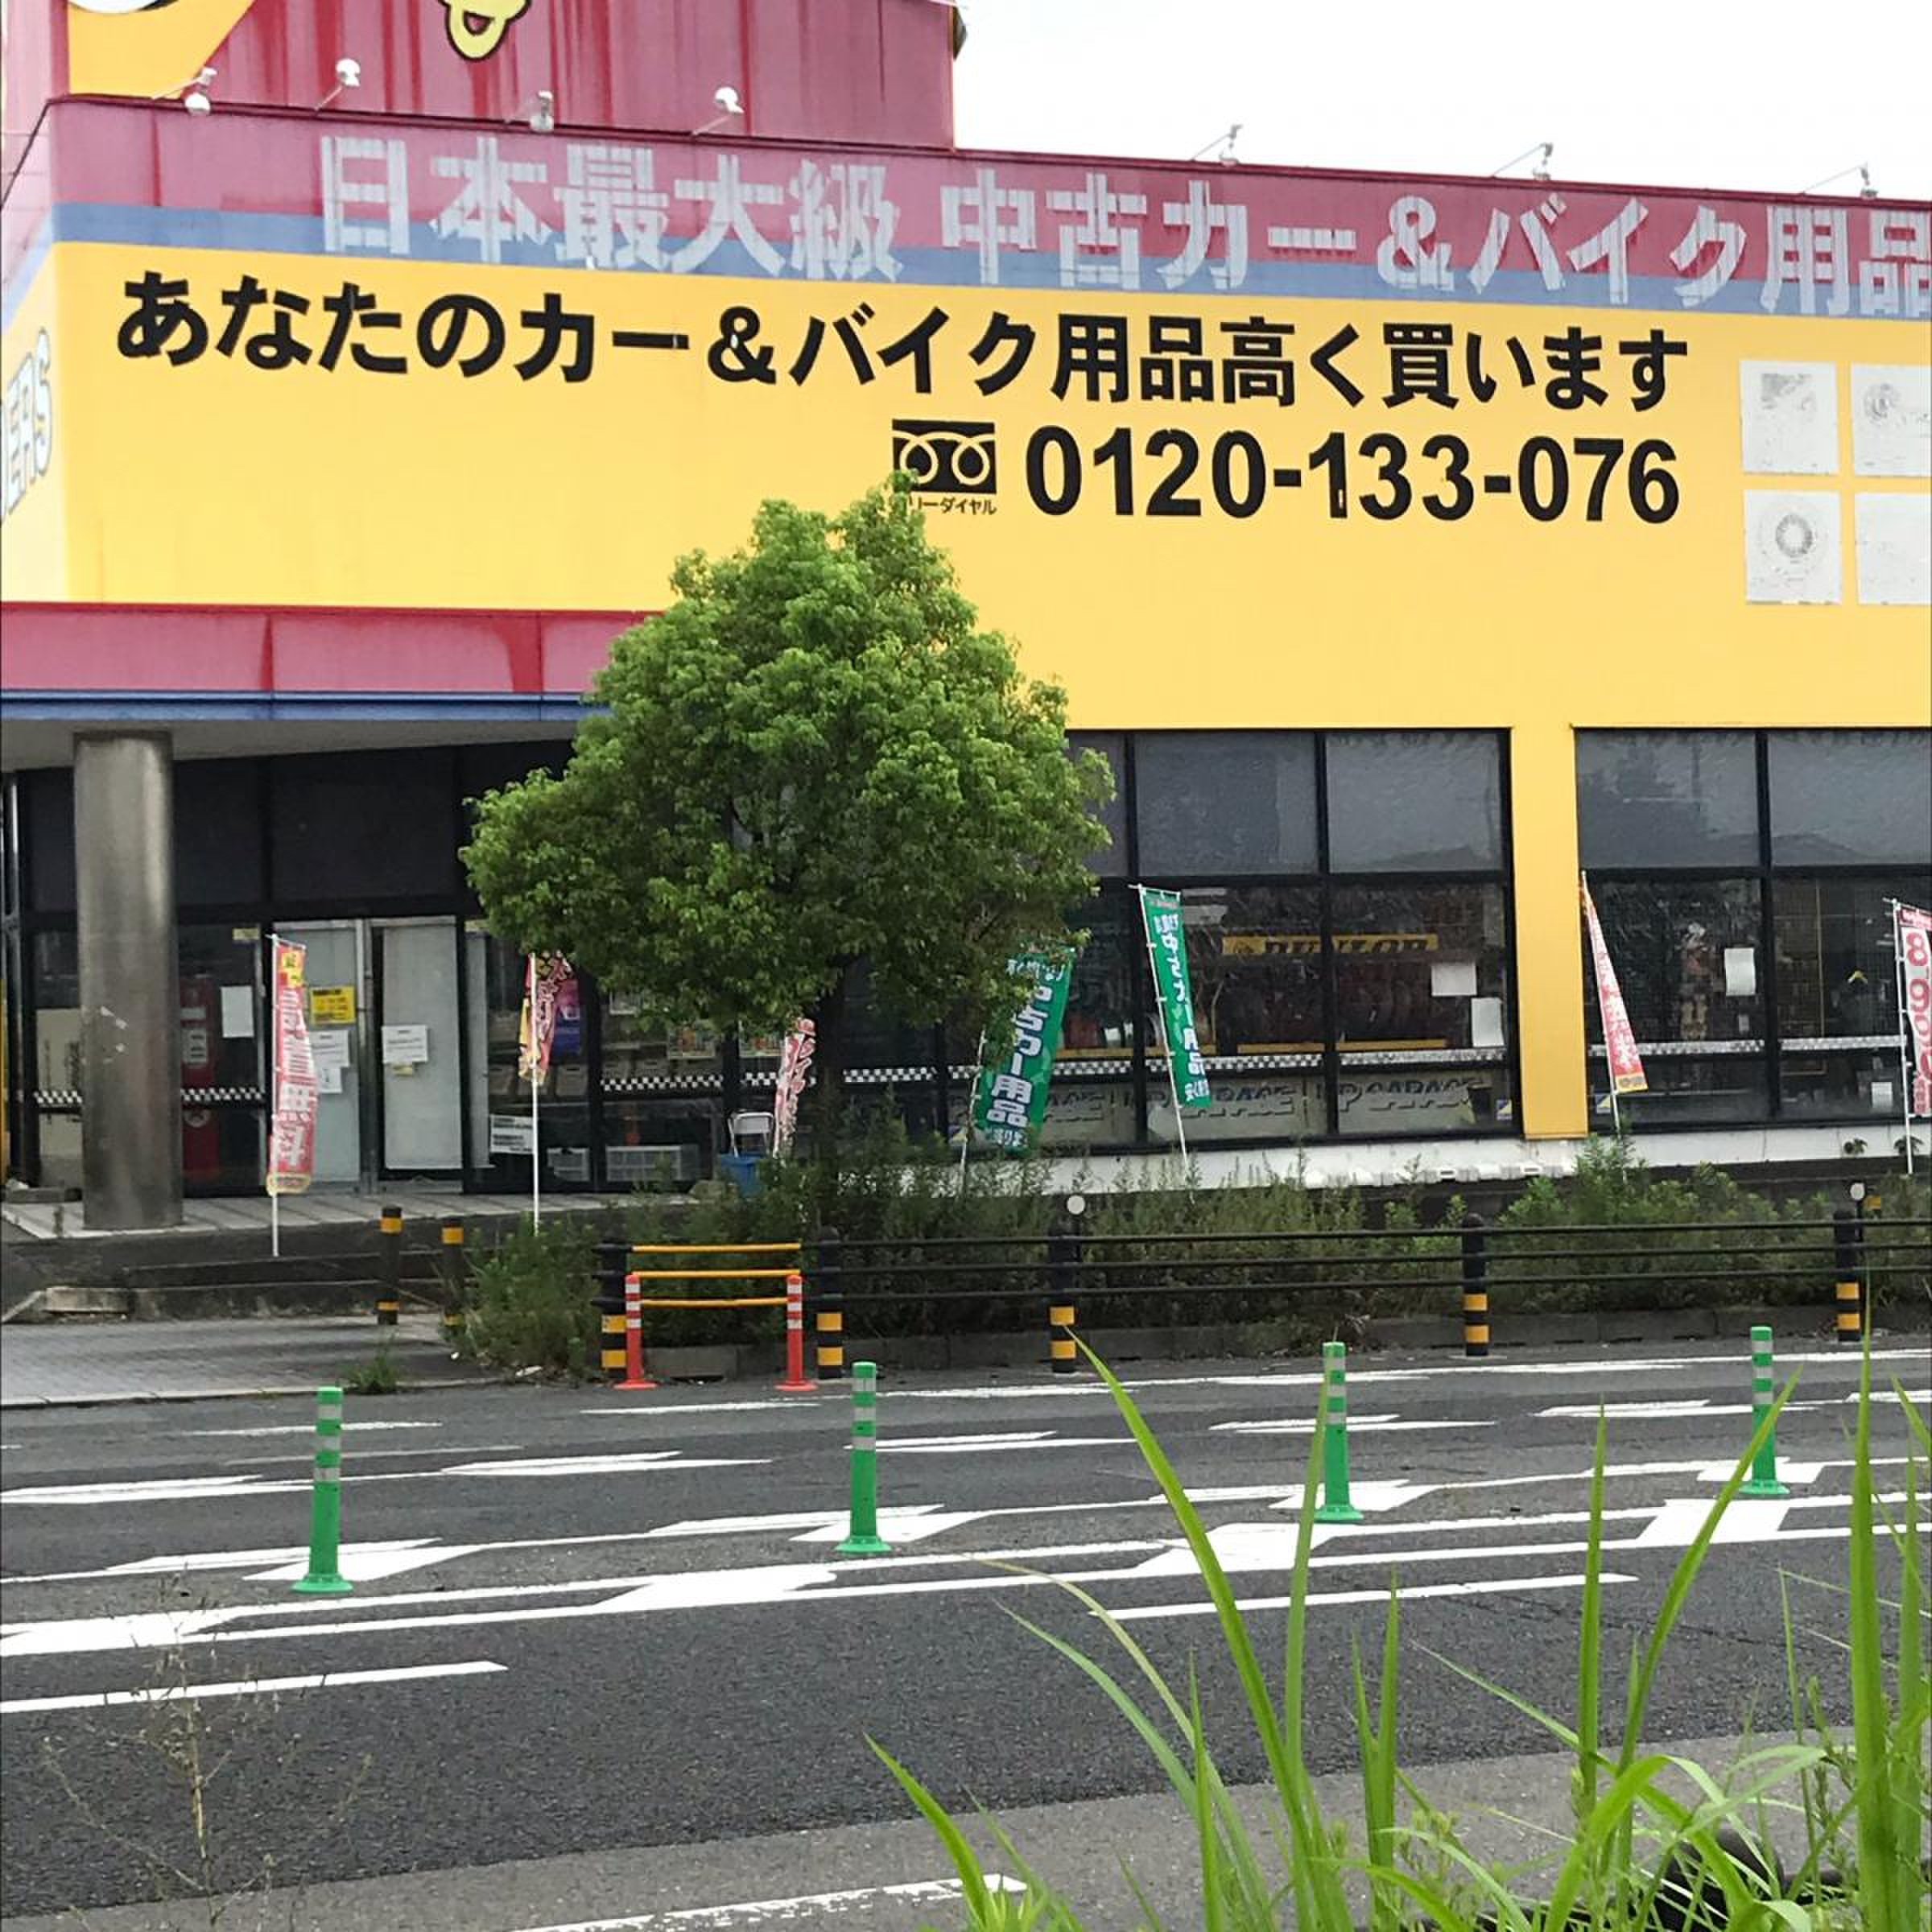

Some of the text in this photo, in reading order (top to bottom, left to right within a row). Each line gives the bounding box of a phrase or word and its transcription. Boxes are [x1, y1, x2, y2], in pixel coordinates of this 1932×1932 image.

[320, 134, 904, 283] 日本最大級
[117, 270, 1688, 412] あなたのカー&バイク用品高く買います
[908, 496, 997, 515] リーダイヤル
[1026, 425, 1680, 524] 0120-133-076
